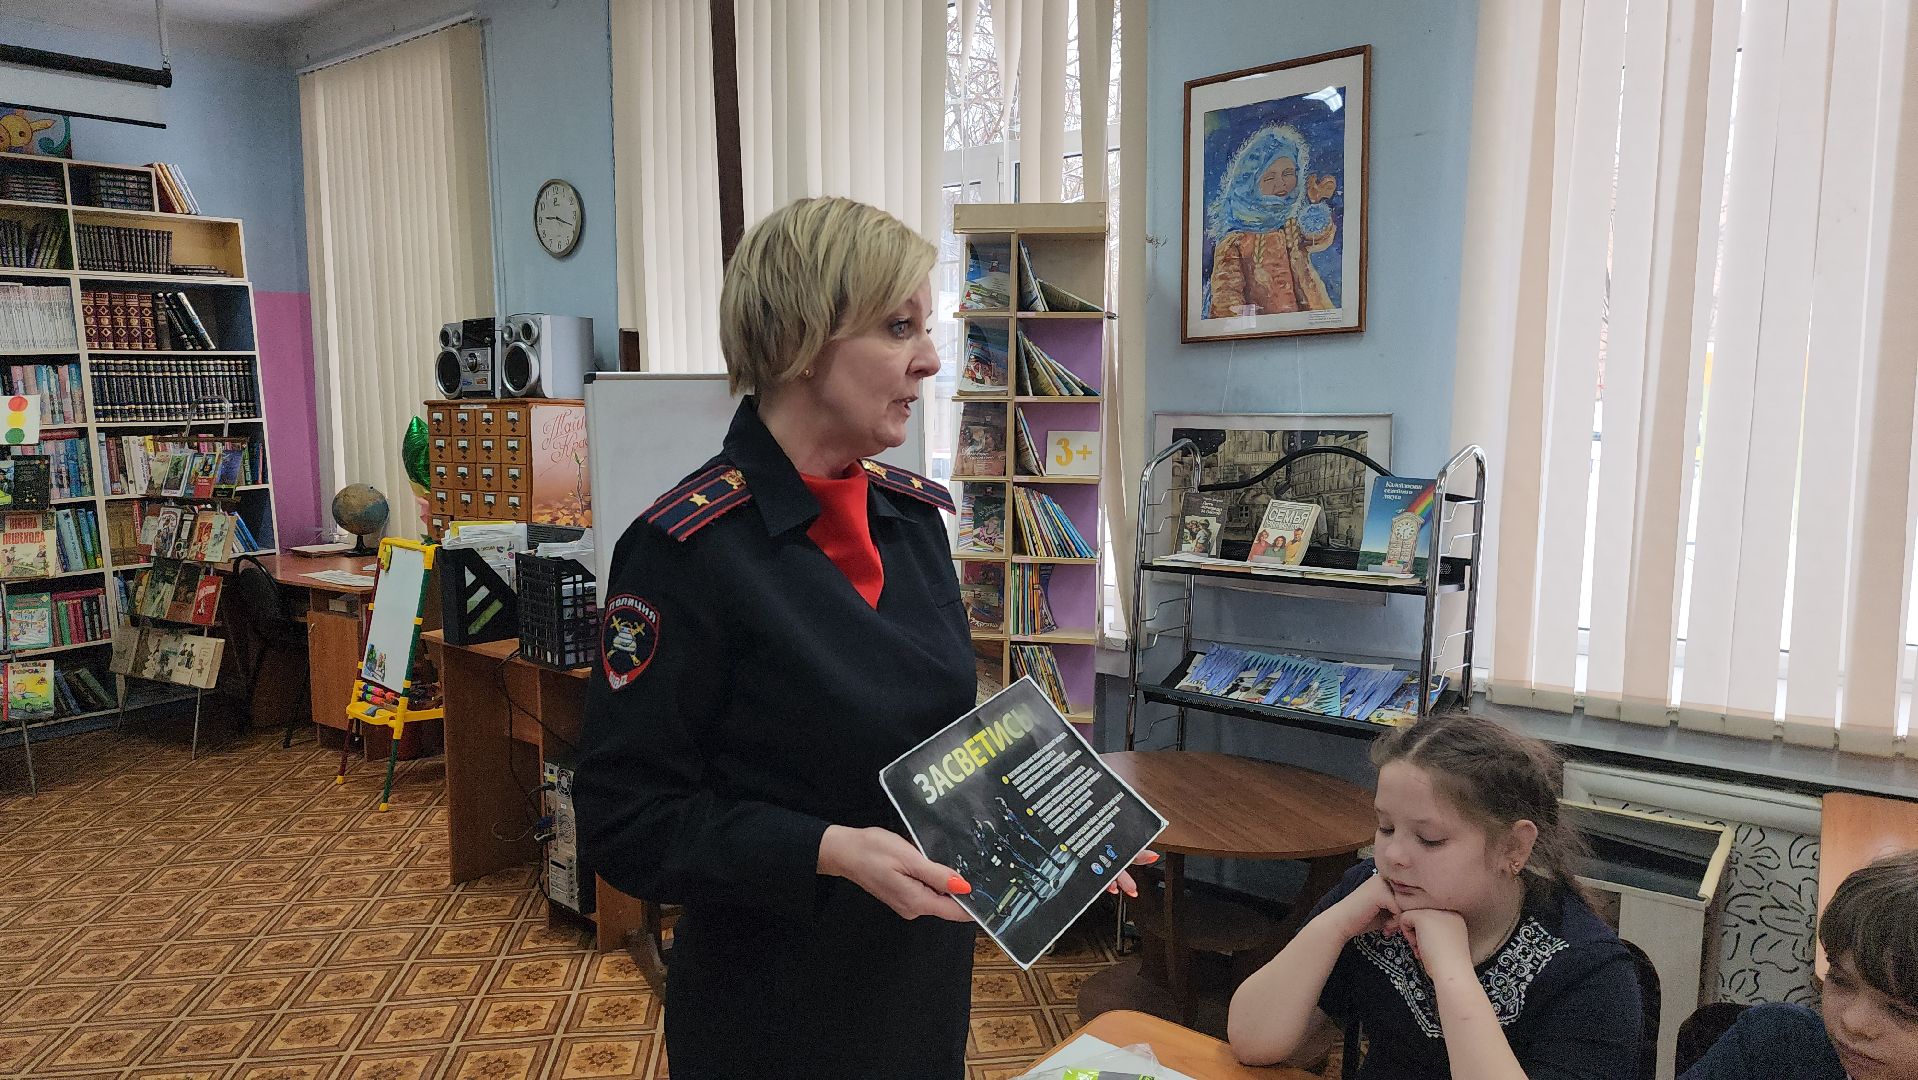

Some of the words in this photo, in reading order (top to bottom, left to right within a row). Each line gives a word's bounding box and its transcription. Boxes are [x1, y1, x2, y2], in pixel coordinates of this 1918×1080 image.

[1056, 437, 1093, 467] 3+
[1268, 507, 1310, 527] СЕМЬЯ
[608, 597, 657, 624] ПОЛИЦИЯ
[913, 703, 1037, 805] ЗАСВЕТИСЬ
